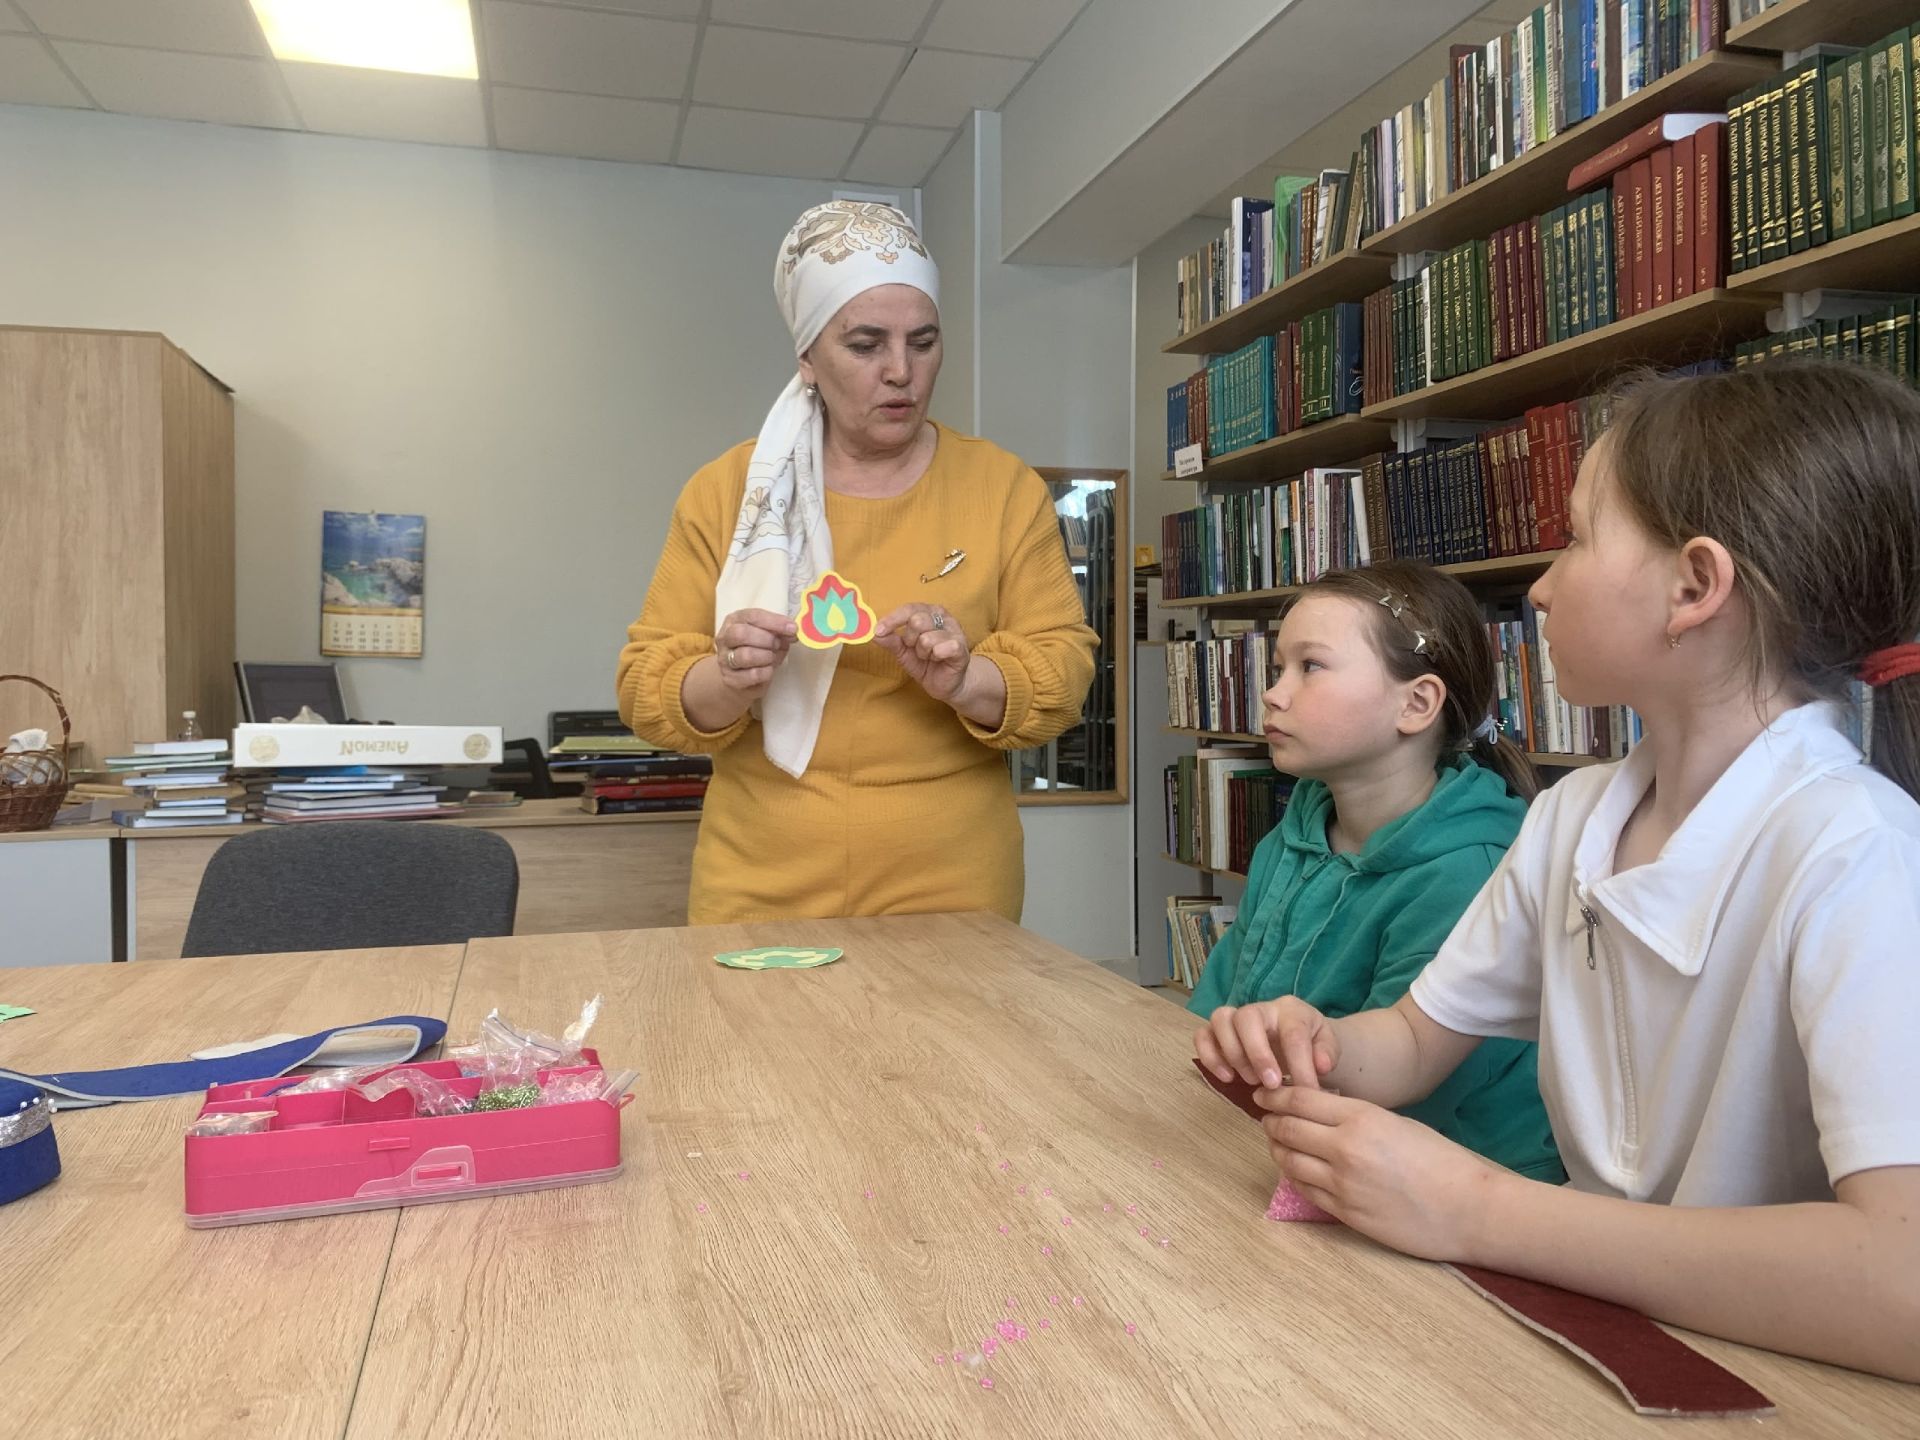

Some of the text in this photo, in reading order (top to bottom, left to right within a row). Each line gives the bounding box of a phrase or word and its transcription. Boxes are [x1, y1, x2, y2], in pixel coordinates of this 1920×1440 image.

[1894, 120, 1903, 139] ГАЯЗ
[1701, 154, 1709, 175] АЯЗ
[1676, 166, 1684, 187] АЯЗ
[1748, 237, 1754, 247] 7
